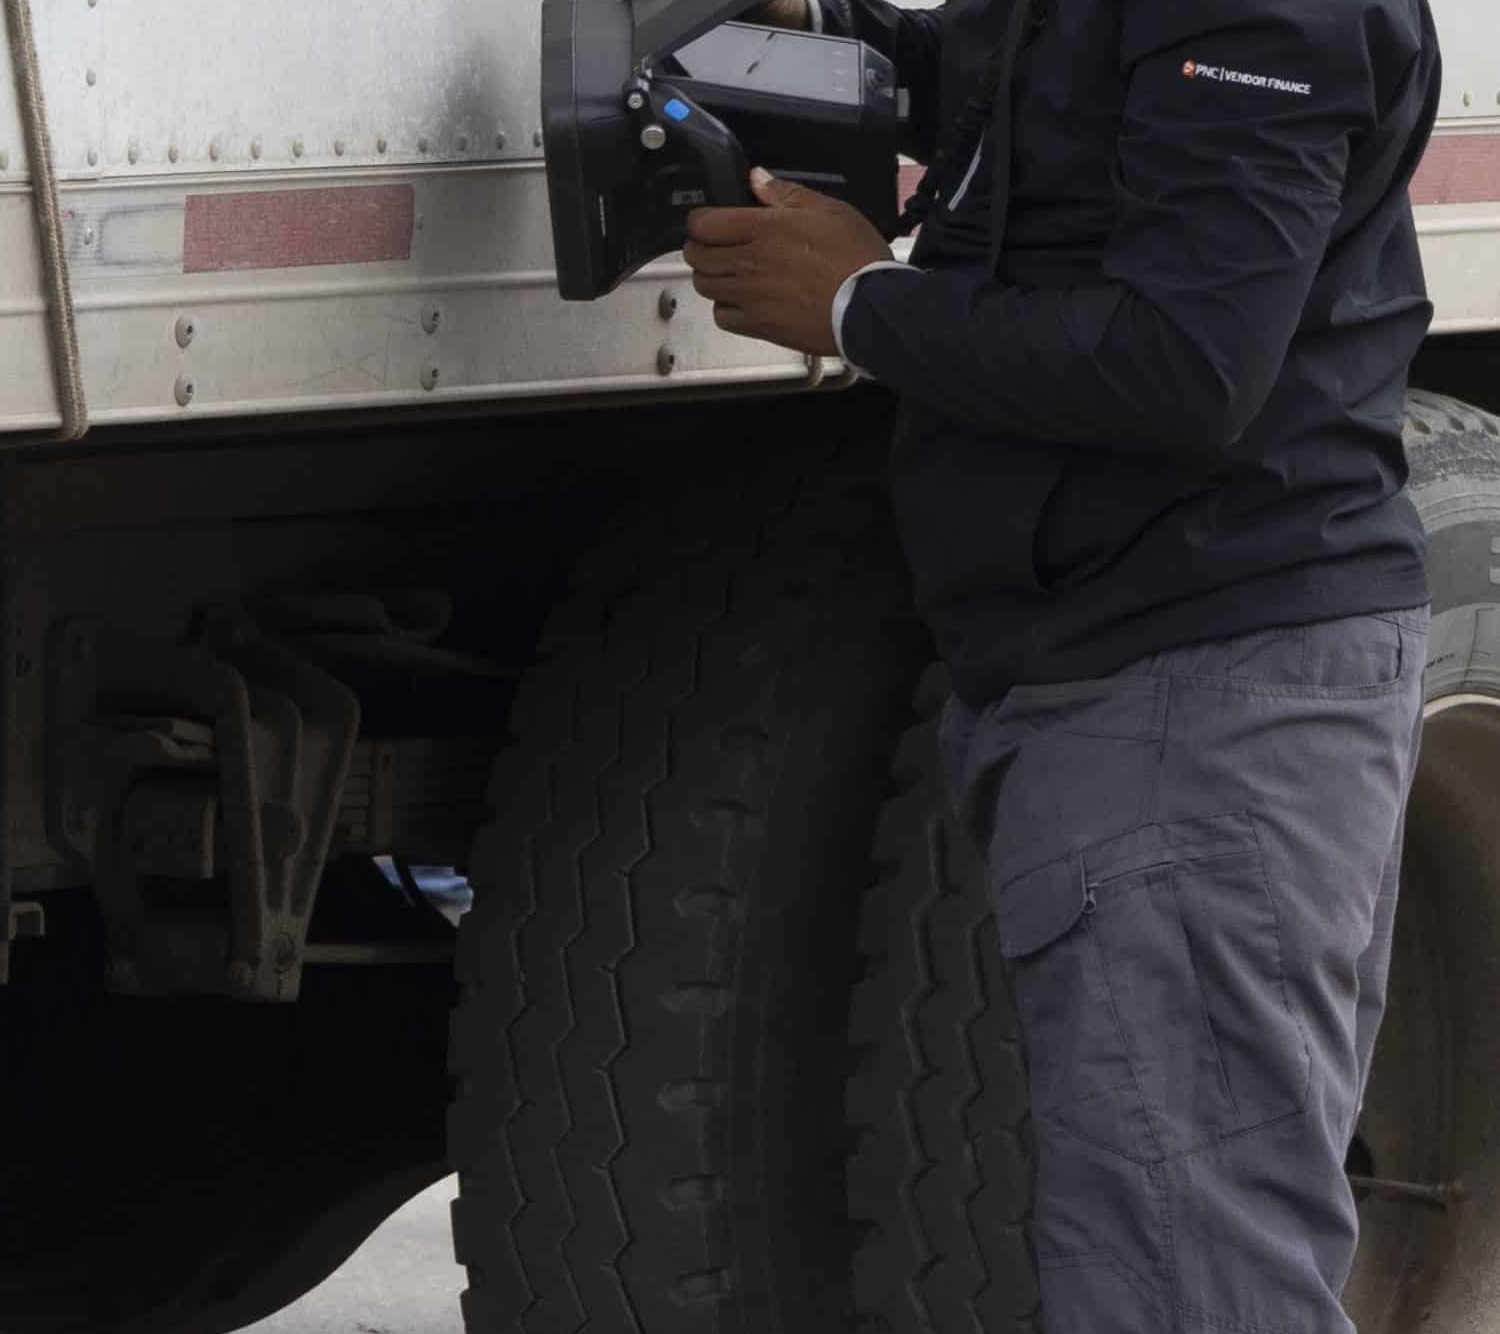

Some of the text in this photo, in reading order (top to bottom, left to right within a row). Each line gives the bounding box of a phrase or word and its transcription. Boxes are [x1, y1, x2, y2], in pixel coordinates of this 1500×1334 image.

[1195, 64, 1312, 95] PNC VENDOR FINANCE
